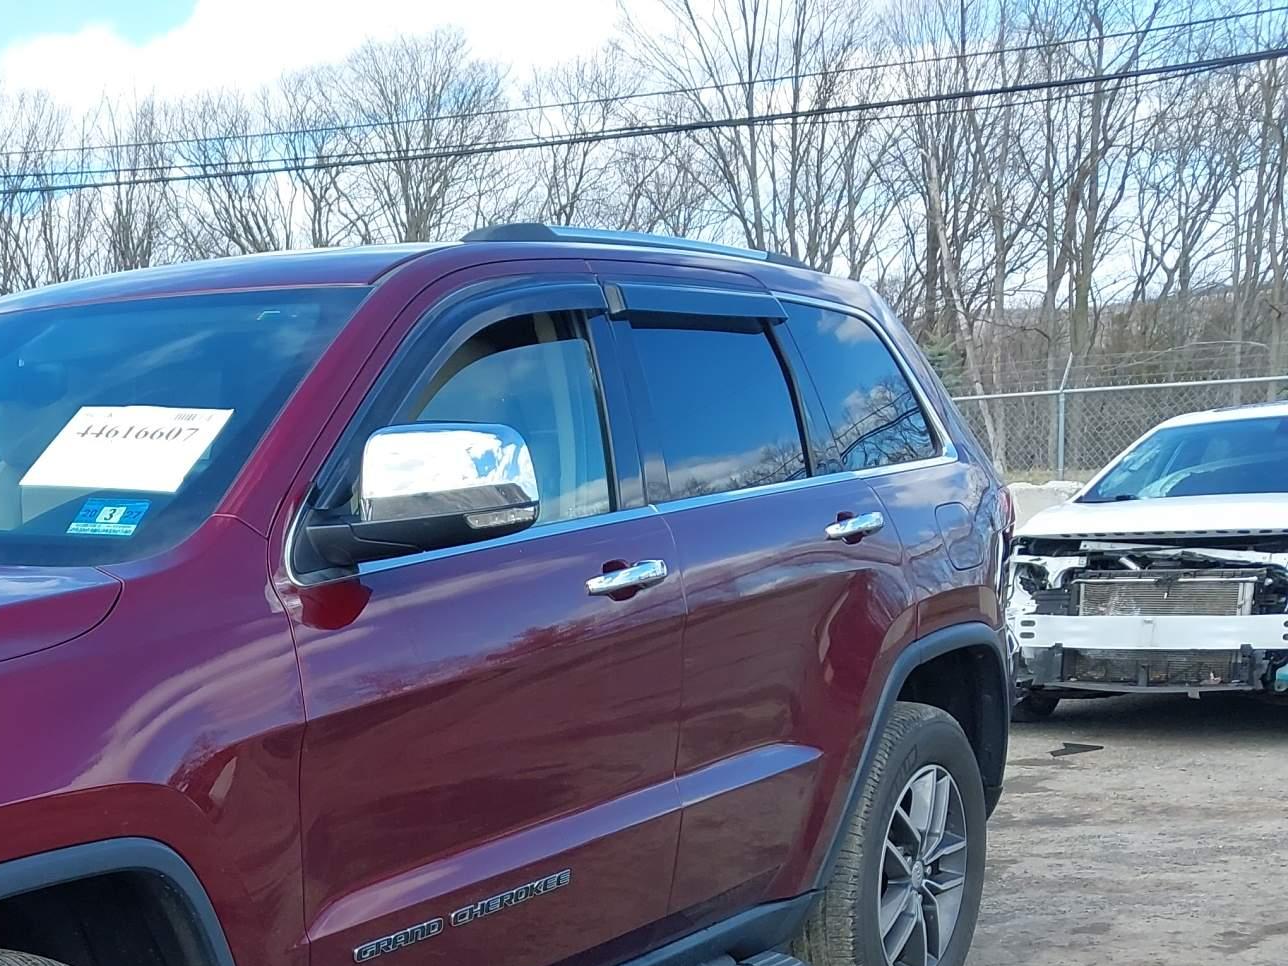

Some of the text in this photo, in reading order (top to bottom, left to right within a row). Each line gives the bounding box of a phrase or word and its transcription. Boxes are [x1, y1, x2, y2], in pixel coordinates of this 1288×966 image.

[76, 424, 200, 441] 44616607
[104, 508, 117, 521] 3
[353, 868, 572, 964] GRAND CHEROKEE
